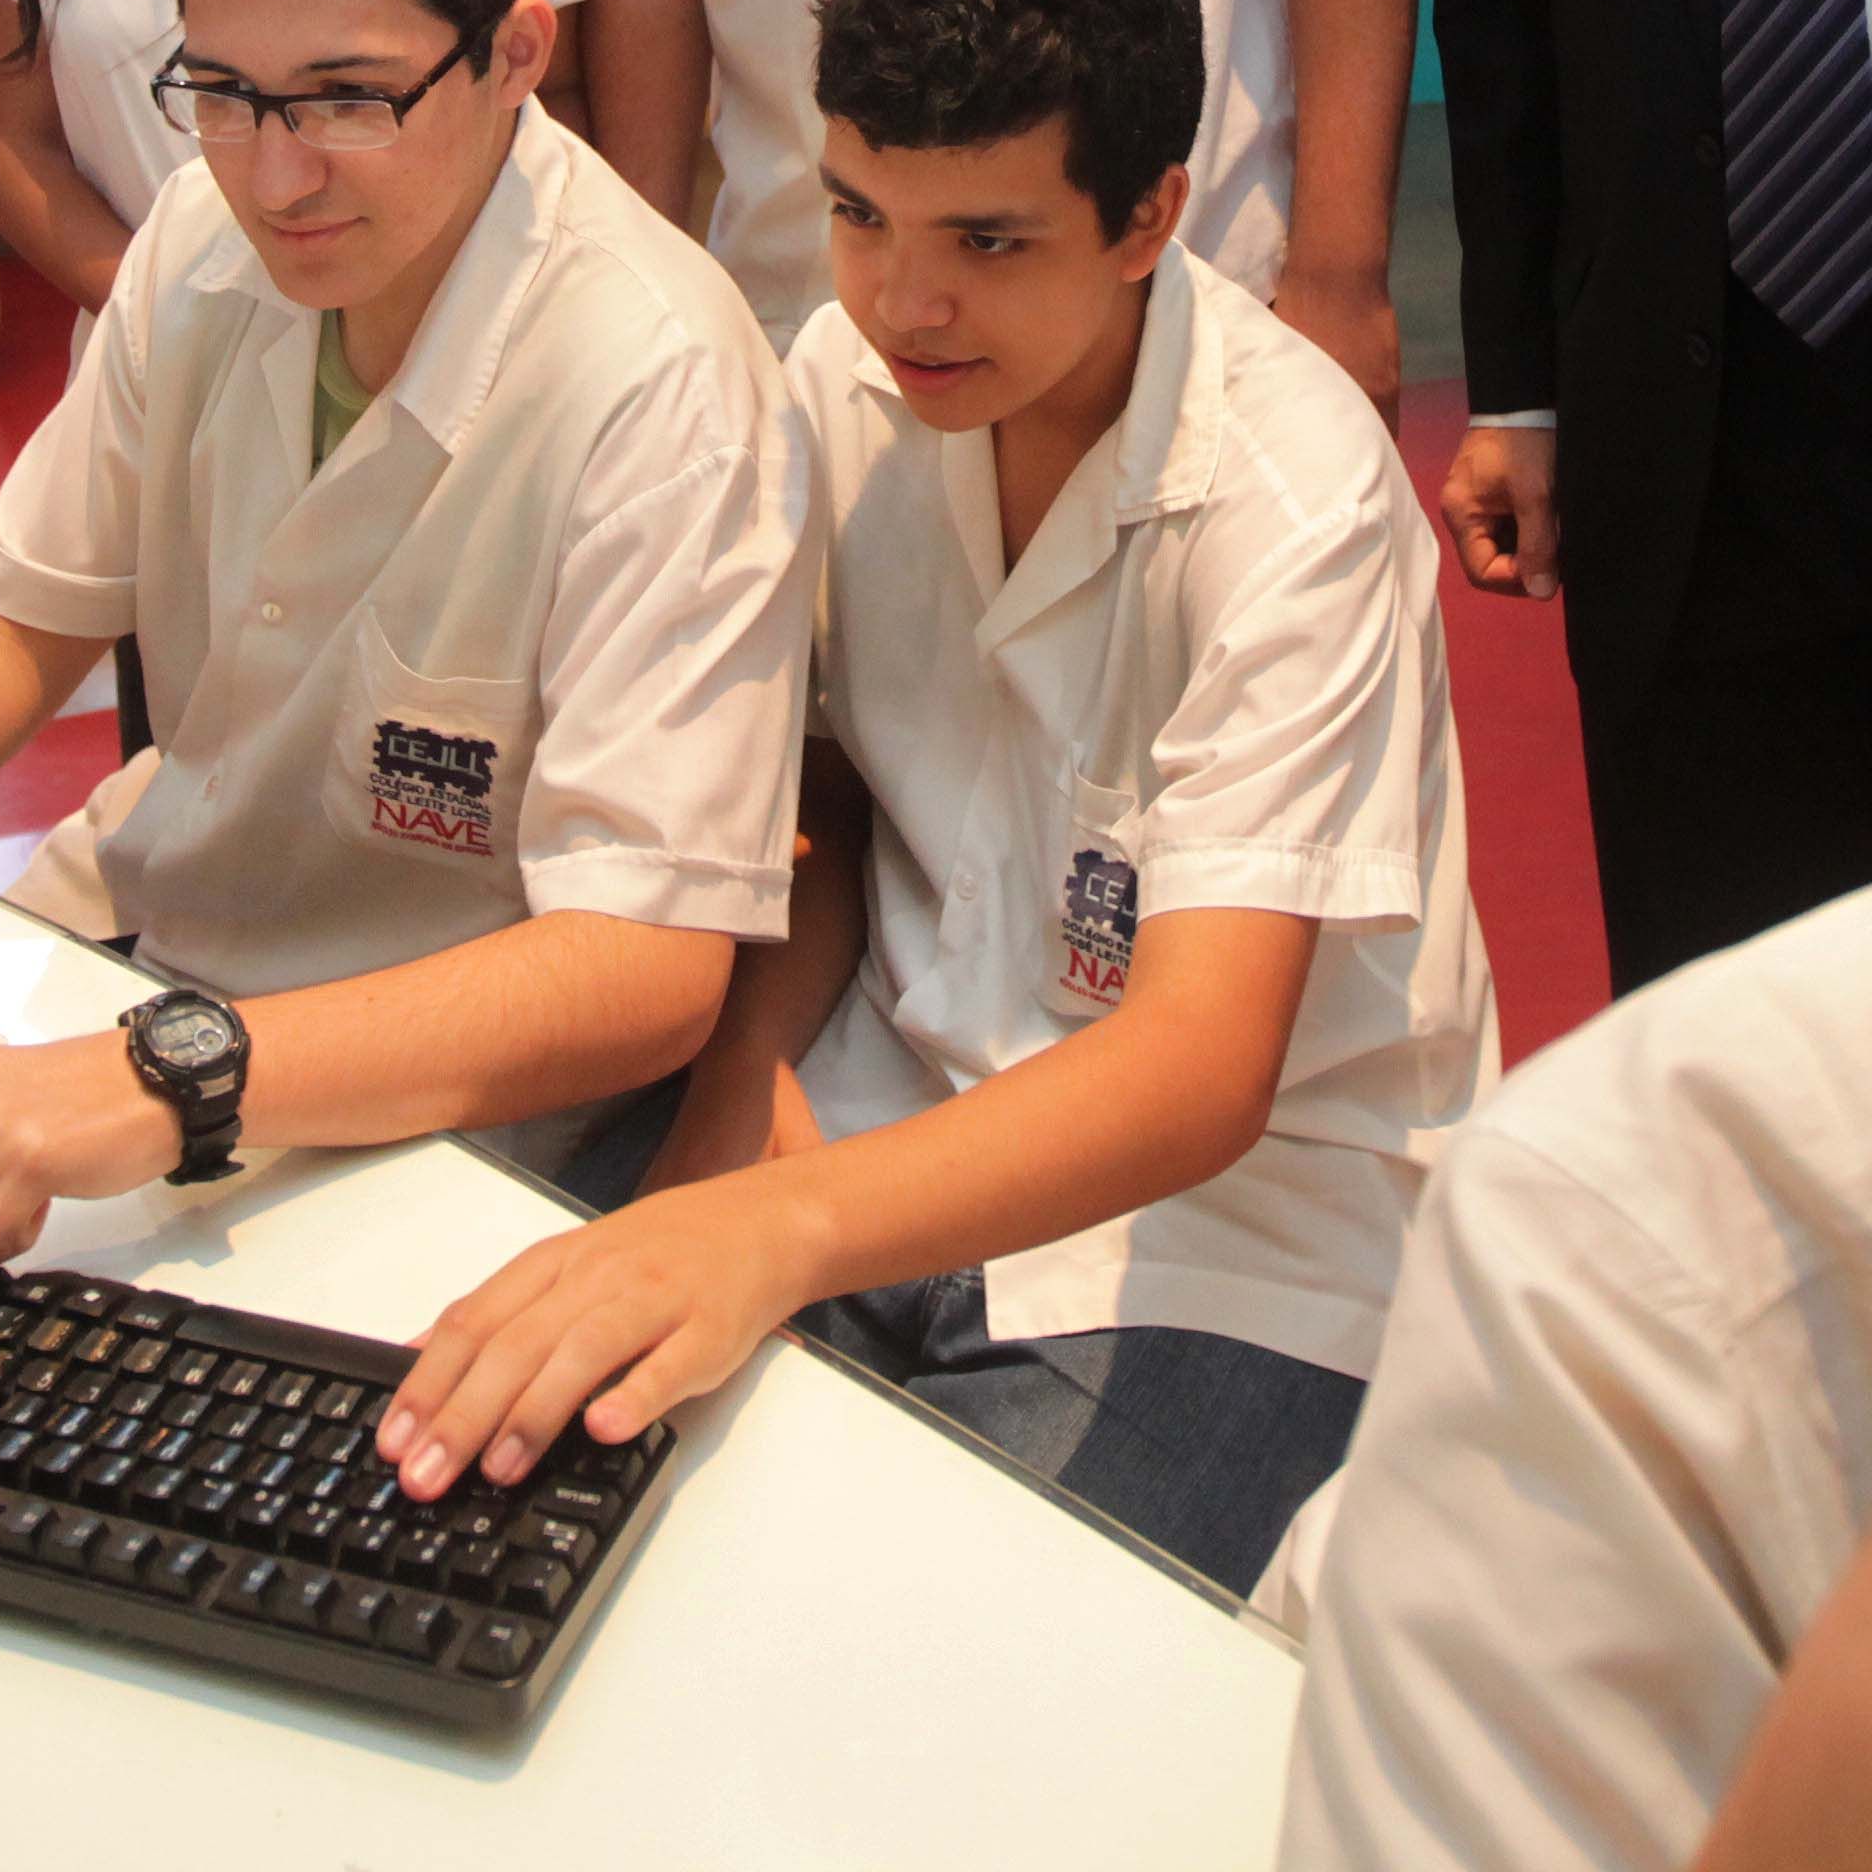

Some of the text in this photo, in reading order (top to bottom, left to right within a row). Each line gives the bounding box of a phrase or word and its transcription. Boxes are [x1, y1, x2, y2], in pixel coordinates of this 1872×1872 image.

[387, 735, 486, 780] CEJLL
[370, 771, 426, 796] COLÉGIO
[374, 797, 491, 849] NAVE
[1061, 916, 1114, 948] COLÉGIO
